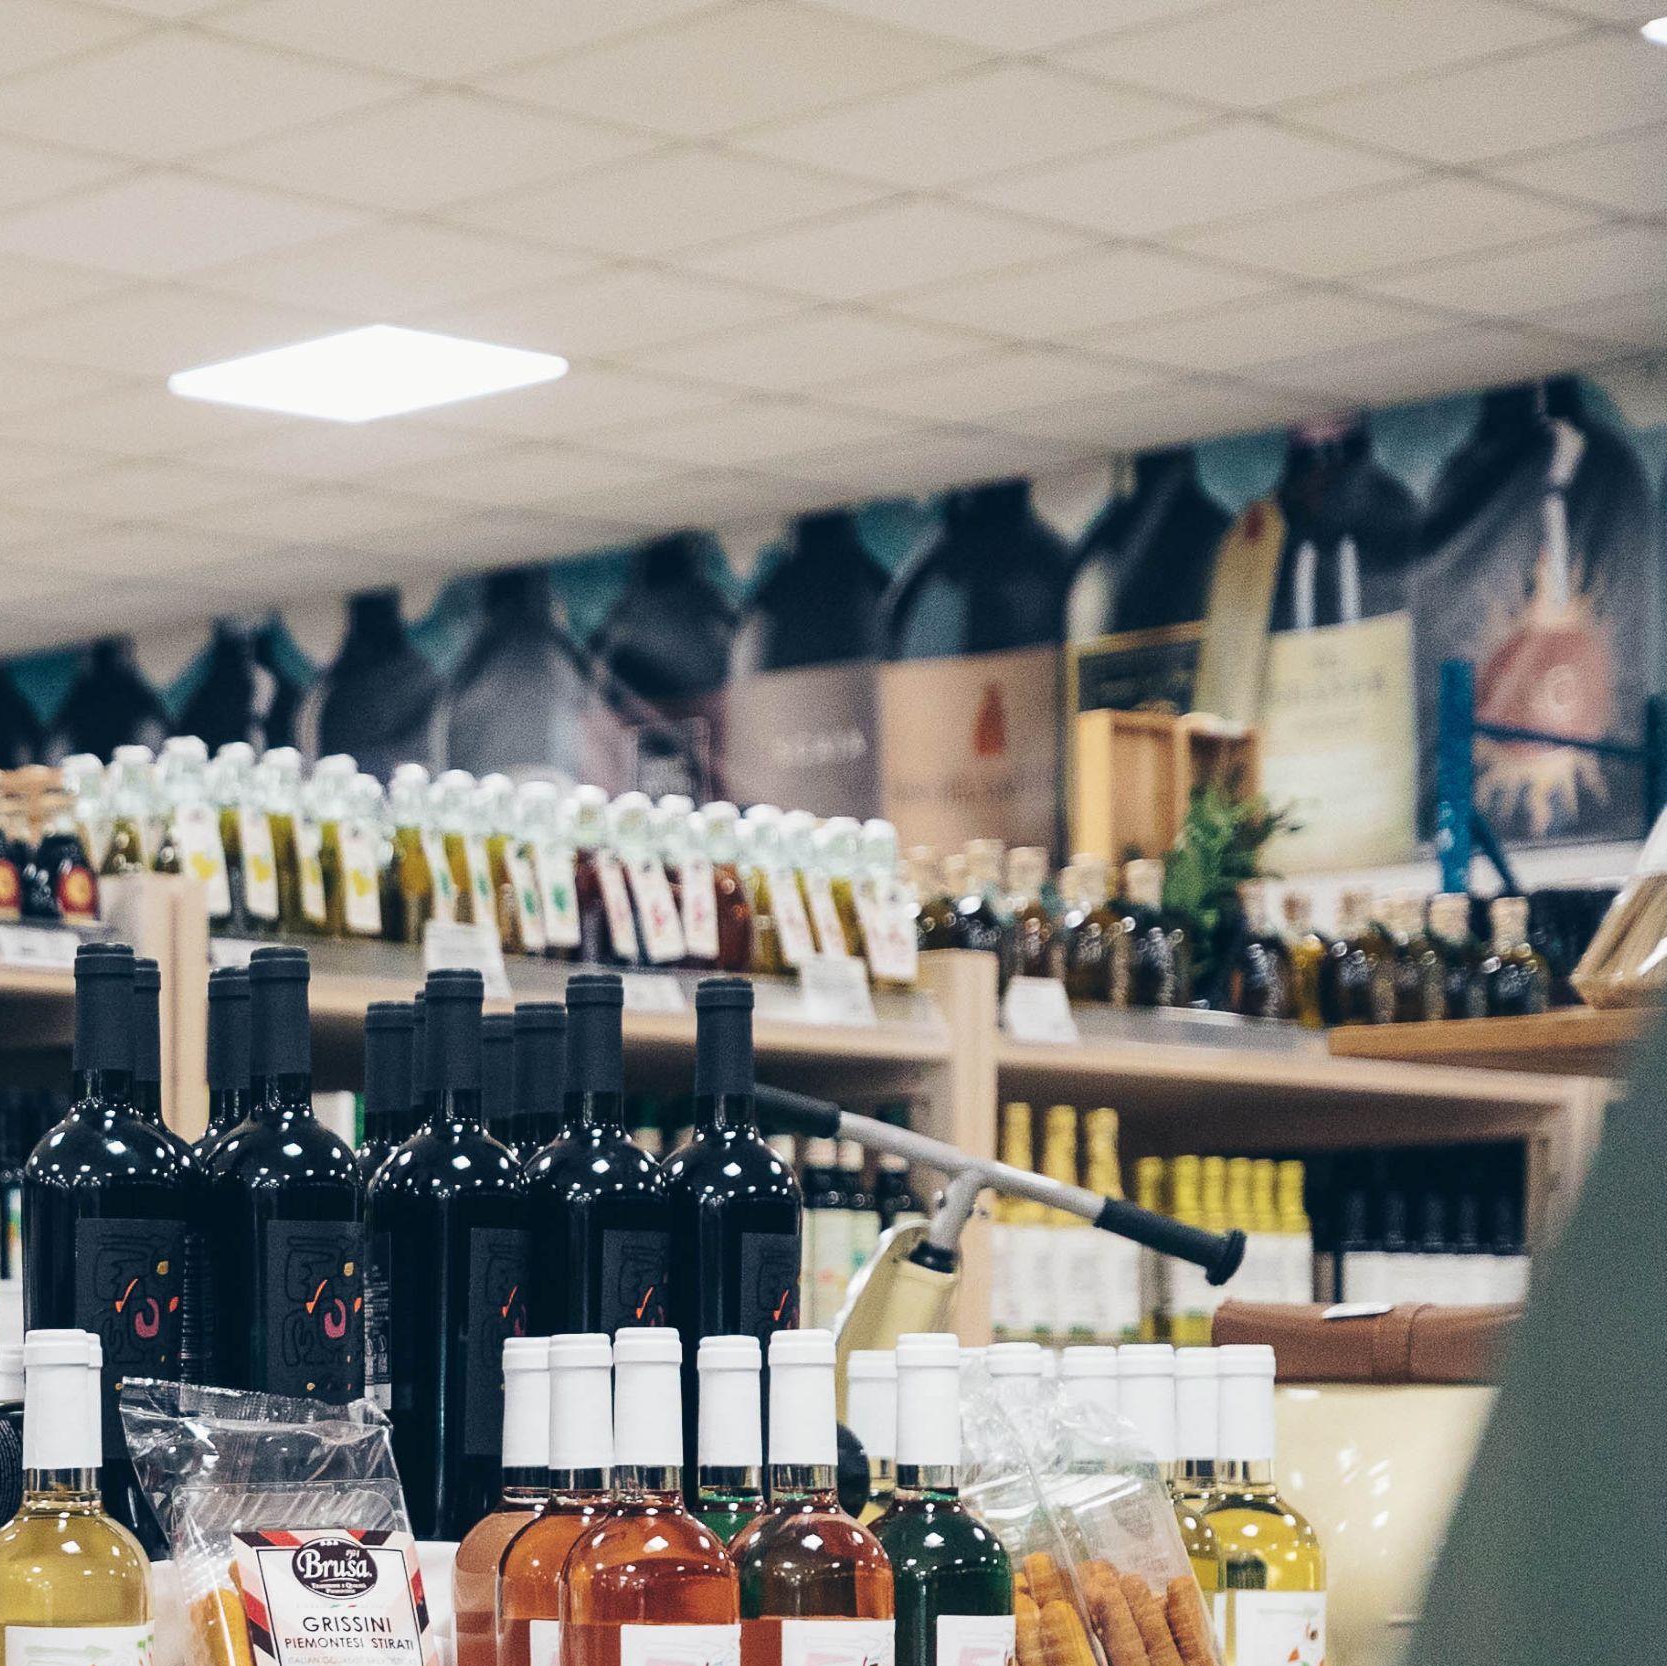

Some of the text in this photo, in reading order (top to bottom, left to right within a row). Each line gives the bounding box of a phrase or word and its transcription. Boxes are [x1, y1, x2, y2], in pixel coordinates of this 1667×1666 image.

[296, 1549, 370, 1579] Brusa
[302, 1616, 392, 1633] GRISSINI
[285, 1637, 414, 1651] PIEMONTESI STIRATI
